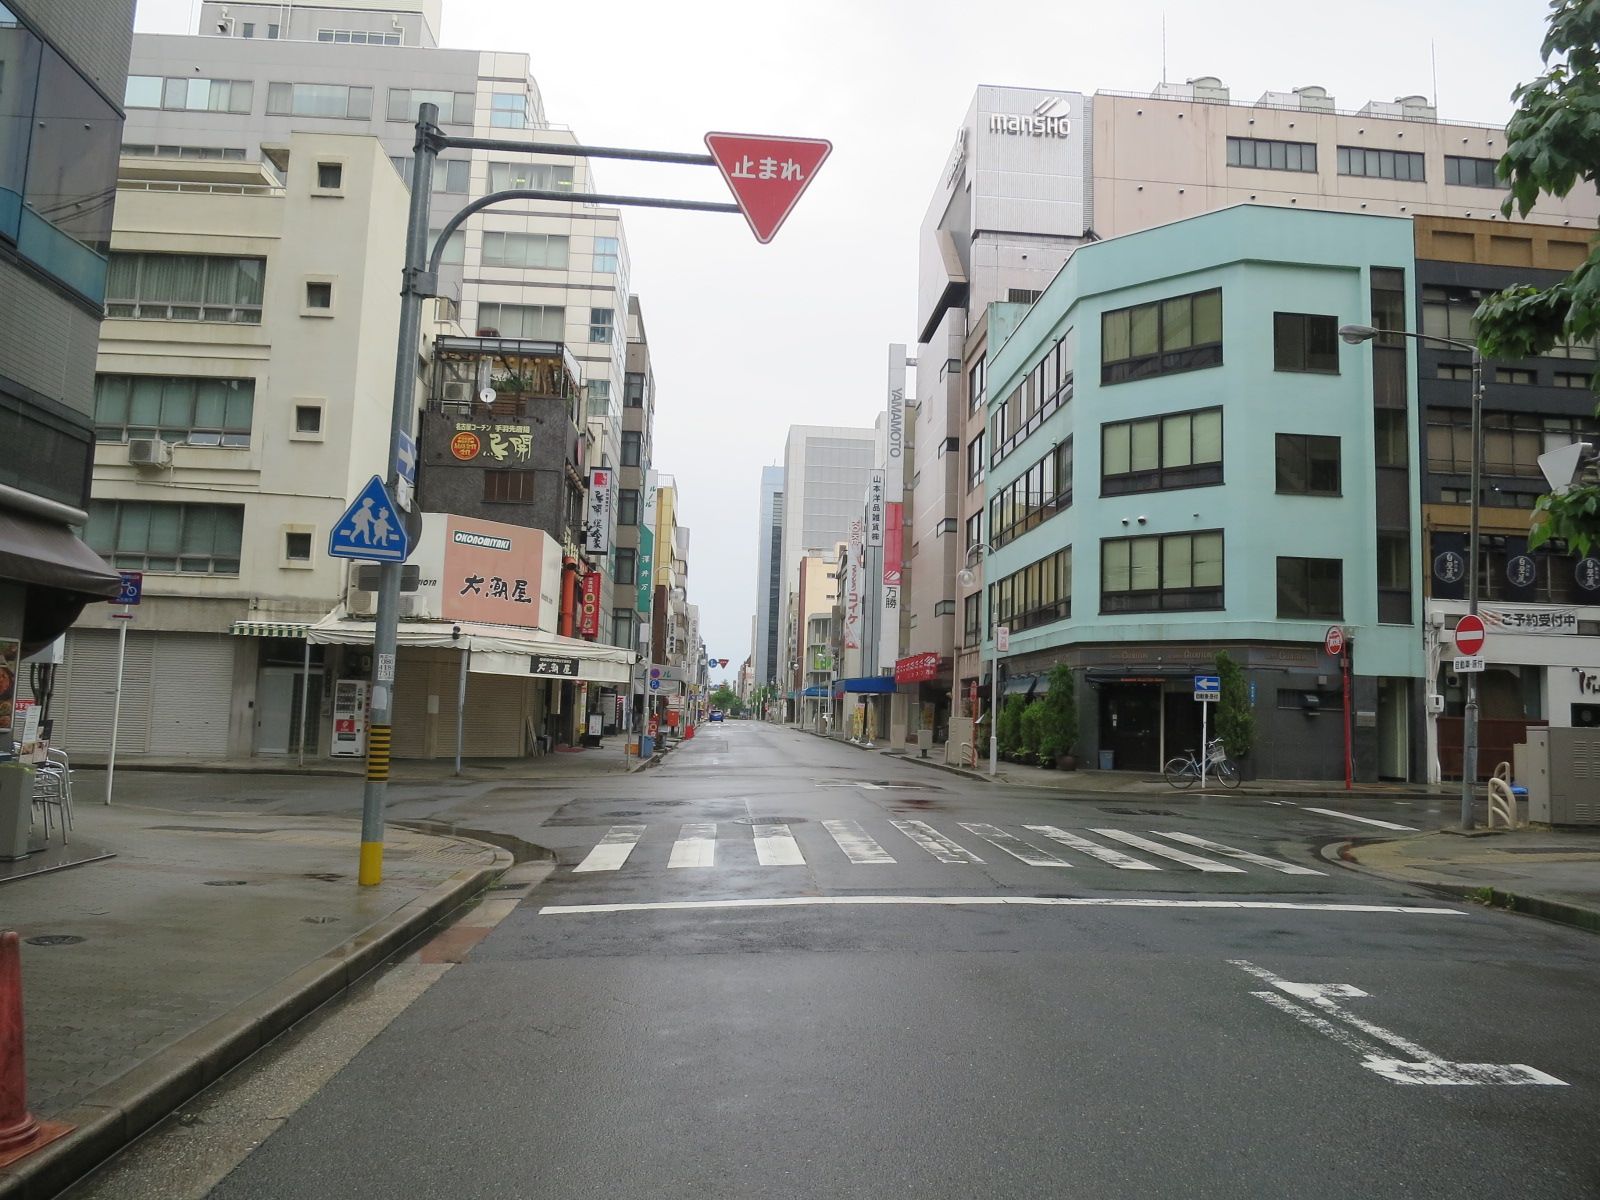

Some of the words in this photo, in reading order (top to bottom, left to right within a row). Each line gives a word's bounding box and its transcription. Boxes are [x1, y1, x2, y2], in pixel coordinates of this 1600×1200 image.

[731, 155, 804, 181] 止まれ
[890, 388, 902, 458] YAMAMOTO
[455, 533, 509, 549] OKONOMIYAKI
[460, 575, 532, 604] 大潮屋
[885, 586, 897, 608] 万勝
[848, 593, 859, 624] コイケ
[1501, 613, 1576, 628] ご予約受付中
